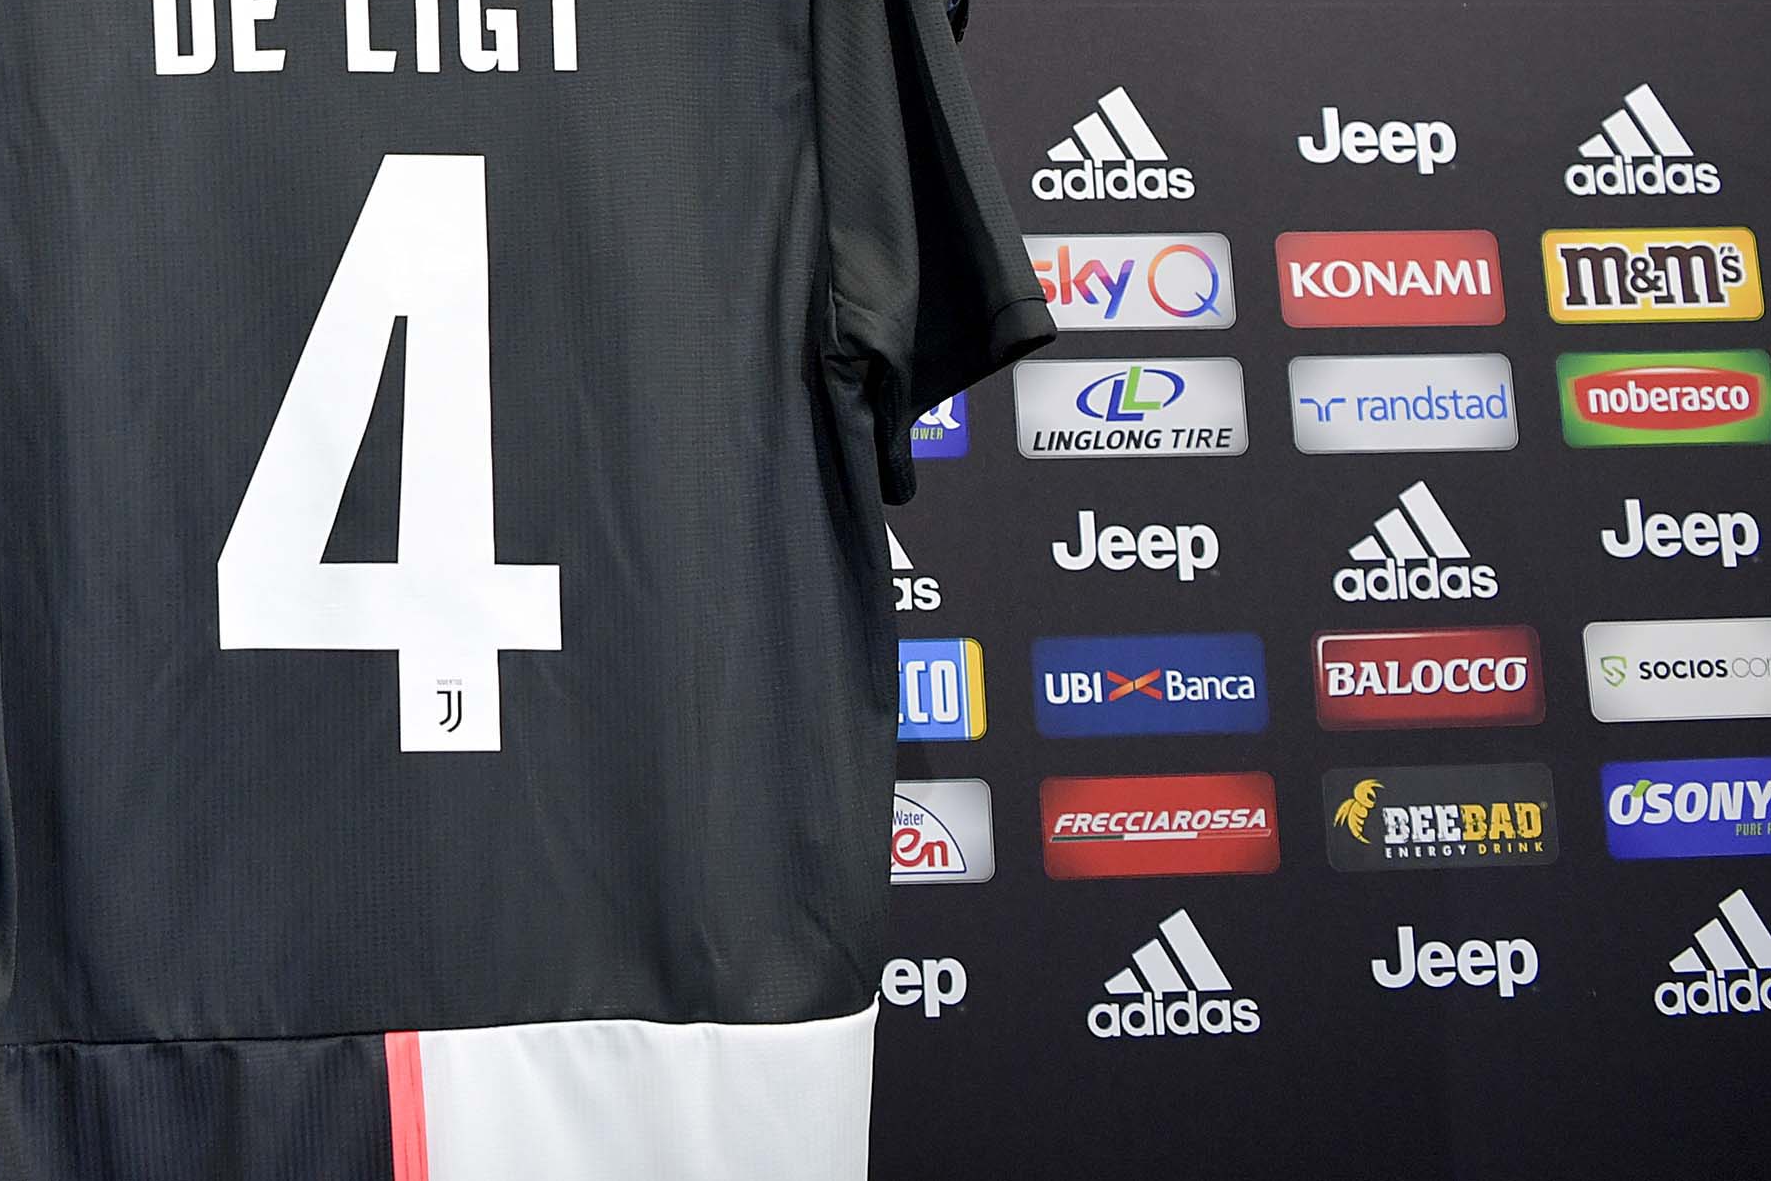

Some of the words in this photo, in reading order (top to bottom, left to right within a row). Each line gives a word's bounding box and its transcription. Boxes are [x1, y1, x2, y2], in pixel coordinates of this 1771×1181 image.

[1297, 107, 1457, 175] Jeep
[1031, 158, 1196, 201] adidas
[1564, 156, 1722, 196] adidas
[1147, 243, 1222, 319] Q
[1289, 260, 1492, 299] KONAMI
[1356, 384, 1509, 422] randstad
[1587, 380, 1750, 414] noberasco
[216, 154, 563, 753] 4
[910, 427, 944, 440] OWER
[1033, 429, 1162, 451] LINGLONG
[1171, 427, 1233, 449] TIRE
[1051, 509, 1219, 581] Jeep
[1601, 498, 1760, 567] Jeep
[1332, 557, 1499, 601] adidas
[1044, 672, 1103, 703] UBI
[1166, 670, 1255, 701] Banca
[1325, 656, 1527, 696] BALOCCO
[1053, 808, 1267, 833] FRECCIAROSSA
[1385, 844, 1467, 857] ENERGY
[1478, 841, 1543, 853] DRINK
[1371, 925, 1539, 998] Jeep
[881, 957, 967, 1018] ep
[1086, 990, 1261, 1037] adidas
